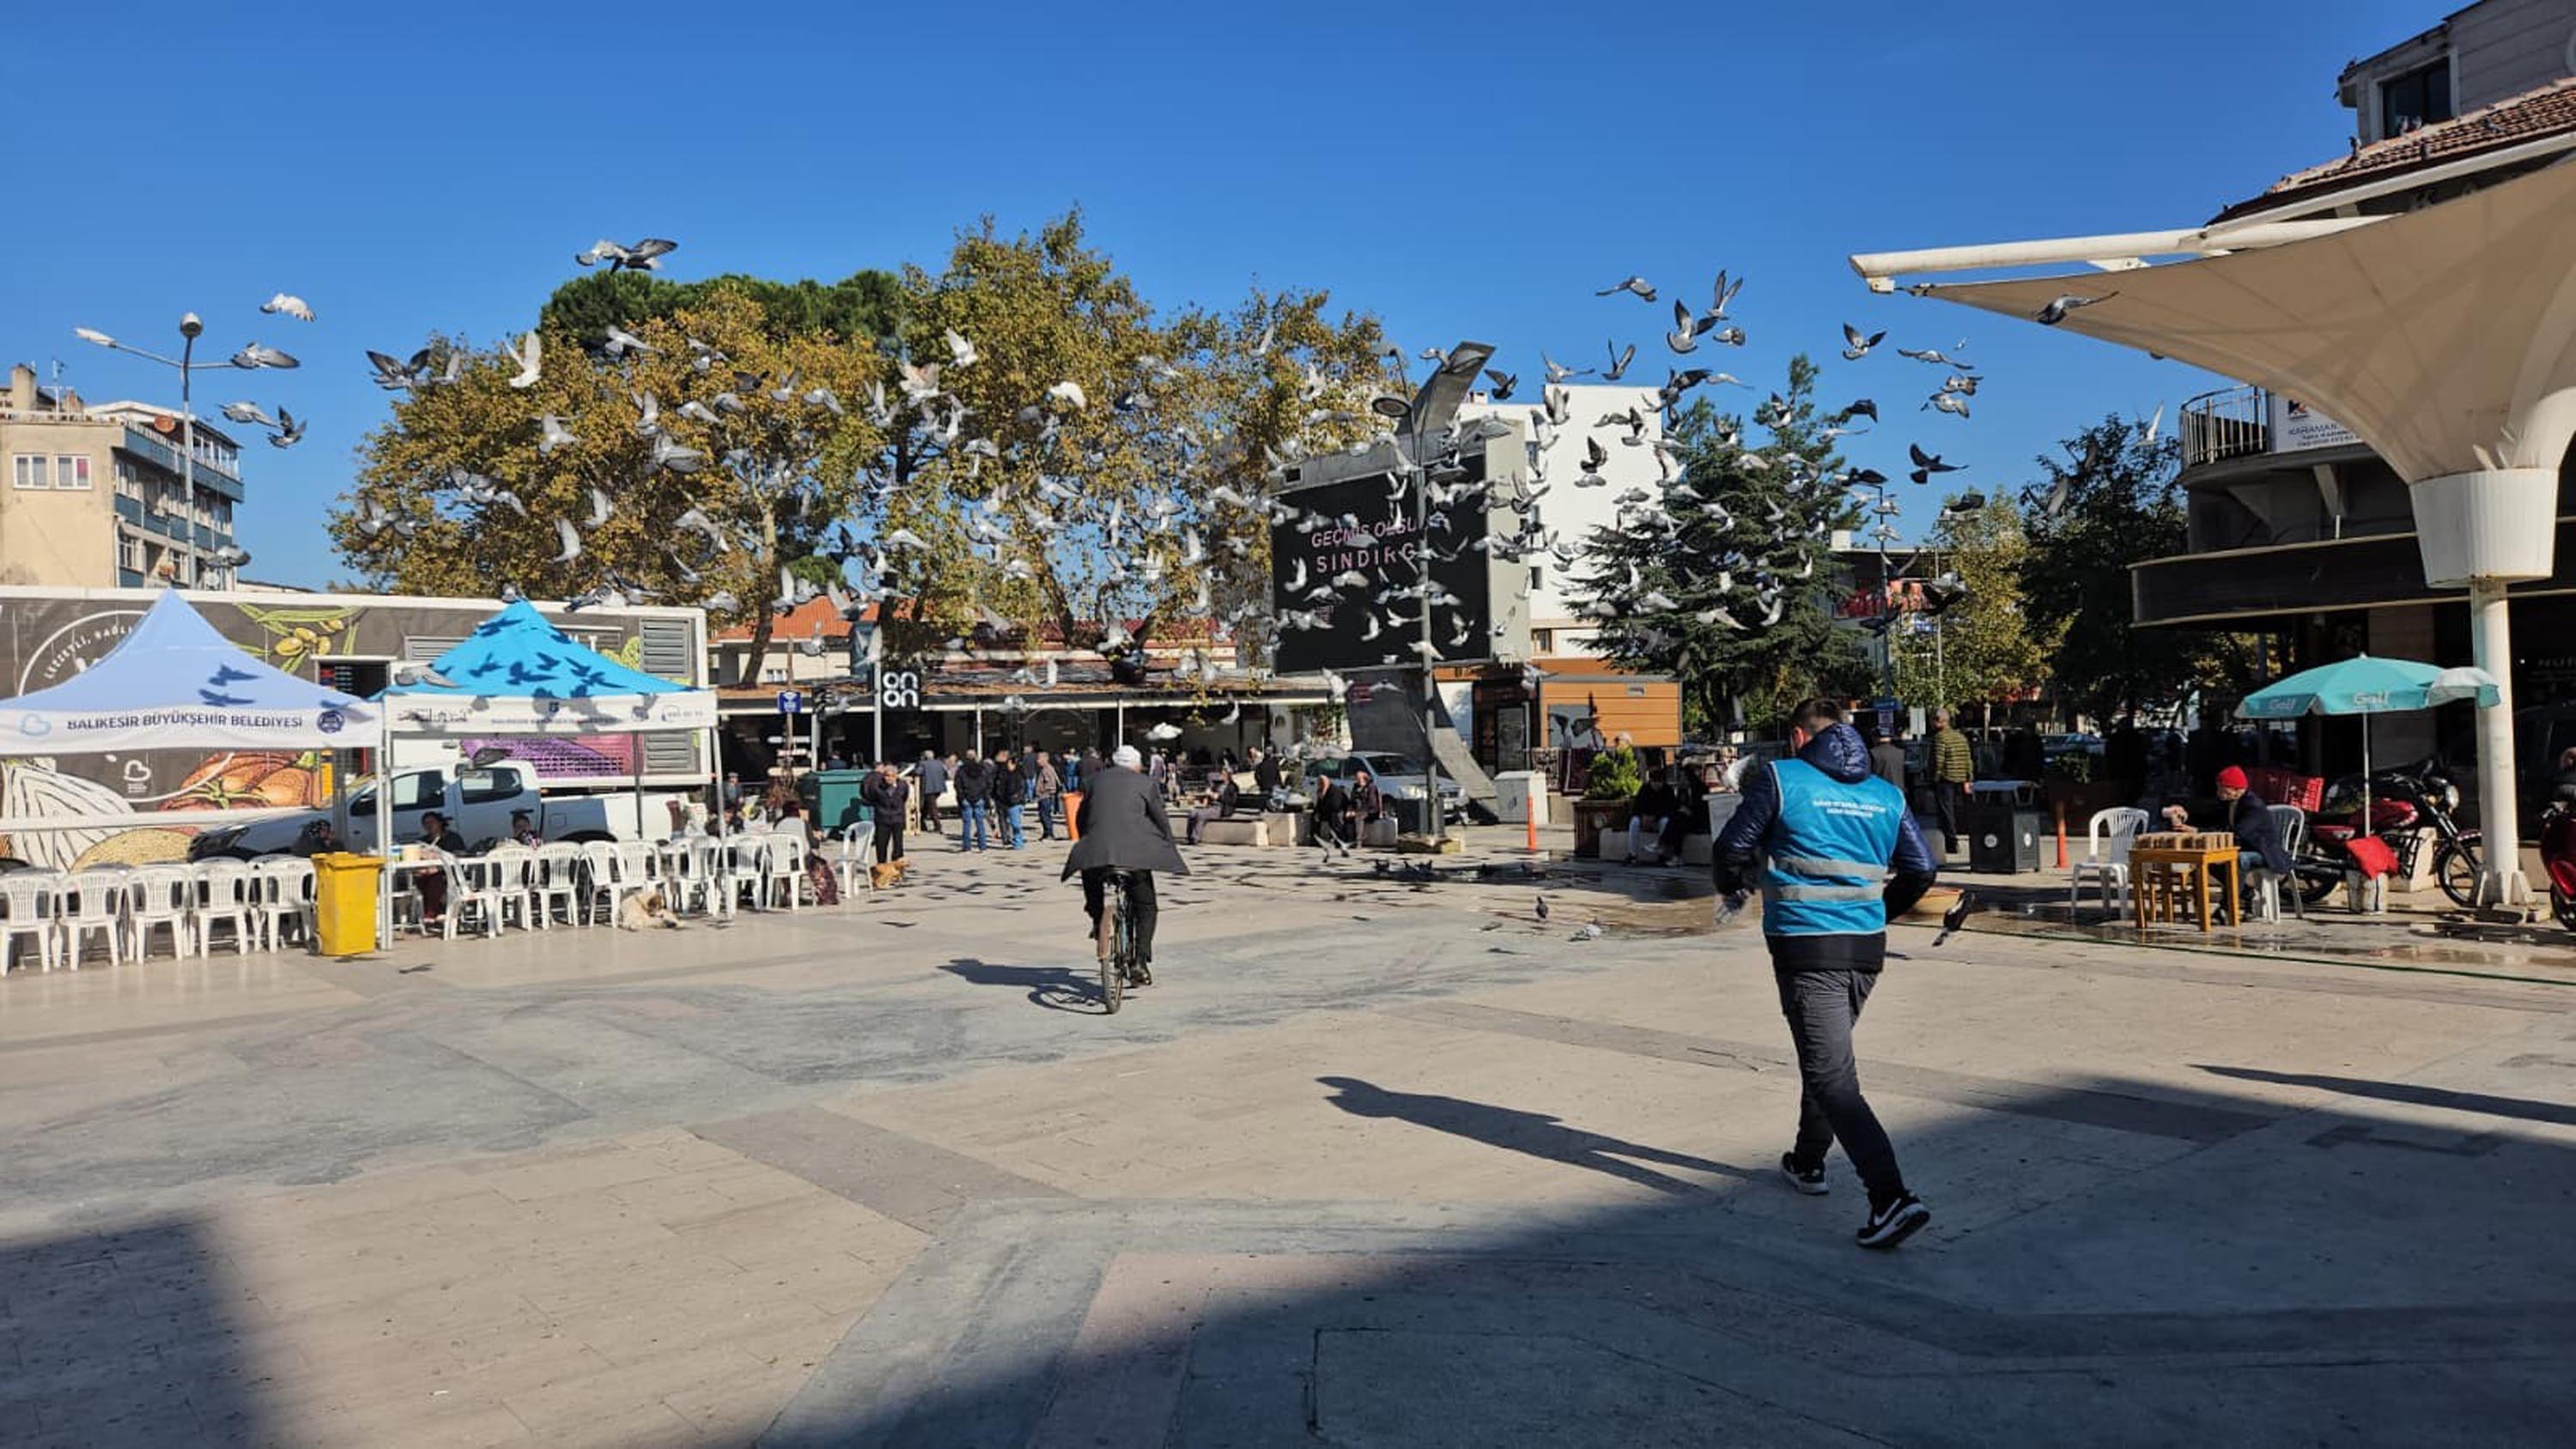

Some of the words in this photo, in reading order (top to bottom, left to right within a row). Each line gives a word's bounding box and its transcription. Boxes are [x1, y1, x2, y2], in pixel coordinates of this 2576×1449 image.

[1374, 516, 1418, 537] OLSU
[1316, 543, 1416, 573] SINDIRG
[883, 672, 918, 689] on
[883, 689, 918, 707] on
[67, 714, 139, 730] BALIKESİR
[143, 712, 227, 726] BÜYÜKŞEHİR
[231, 714, 302, 728] BELEDİYESİ
